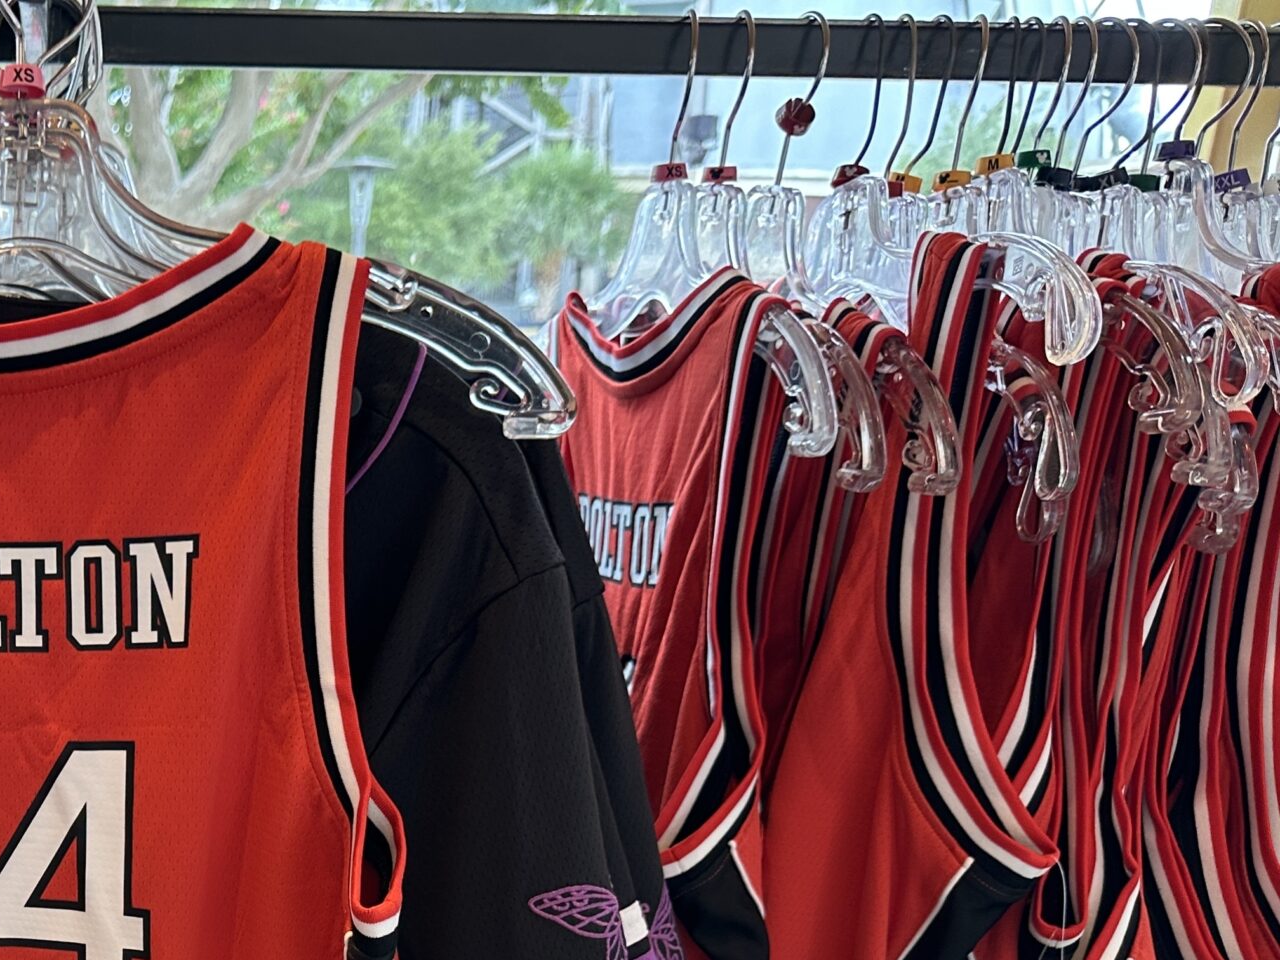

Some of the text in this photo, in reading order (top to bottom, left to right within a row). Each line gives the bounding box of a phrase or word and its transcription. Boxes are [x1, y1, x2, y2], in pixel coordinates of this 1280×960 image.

[13, 68, 34, 82] XS
[987, 158, 999, 171] M
[665, 165, 683, 178] XS
